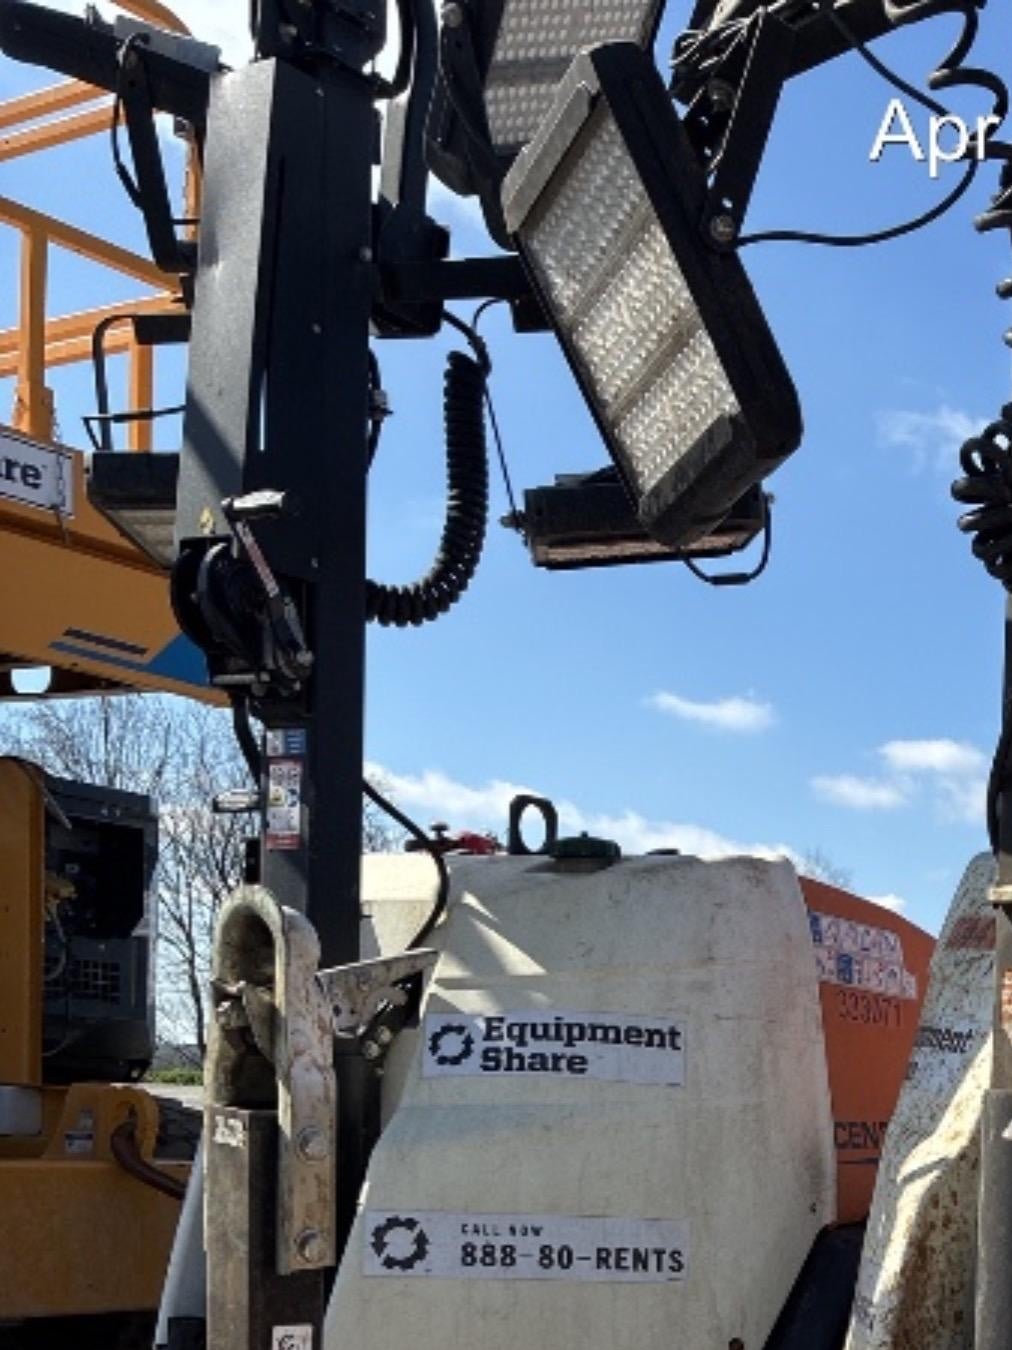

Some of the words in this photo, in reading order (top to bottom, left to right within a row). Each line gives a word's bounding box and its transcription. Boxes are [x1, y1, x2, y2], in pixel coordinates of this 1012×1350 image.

[0, 456, 42, 490] re
[481, 1016, 682, 1051] Equipment
[479, 1046, 589, 1075] Share
[460, 1222, 501, 1237] CALL
[460, 1242, 685, 1274] 888-80-RENTS
